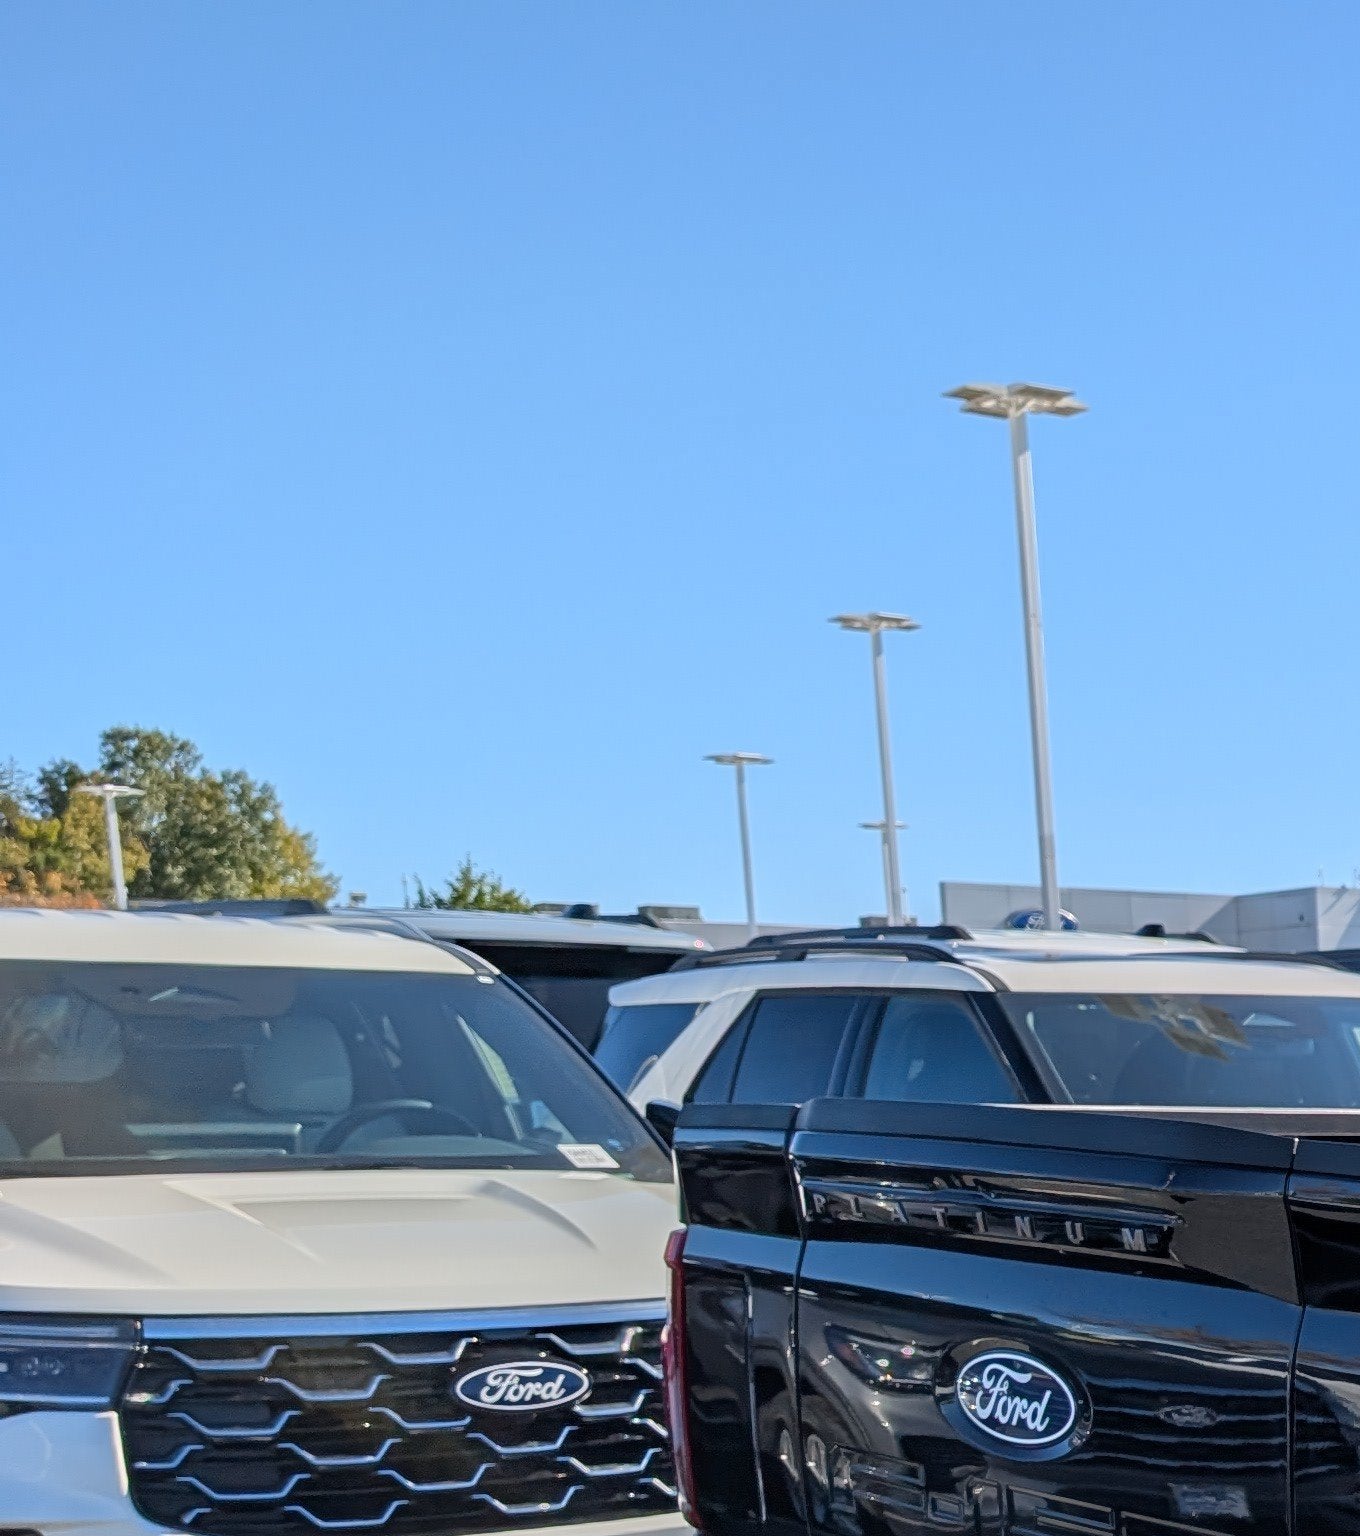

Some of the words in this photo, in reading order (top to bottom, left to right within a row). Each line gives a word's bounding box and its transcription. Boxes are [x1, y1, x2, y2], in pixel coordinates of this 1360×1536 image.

[811, 1192, 1147, 1252] PLATINUM
[480, 1367, 566, 1404] Ford
[976, 1363, 1052, 1432] Ford
